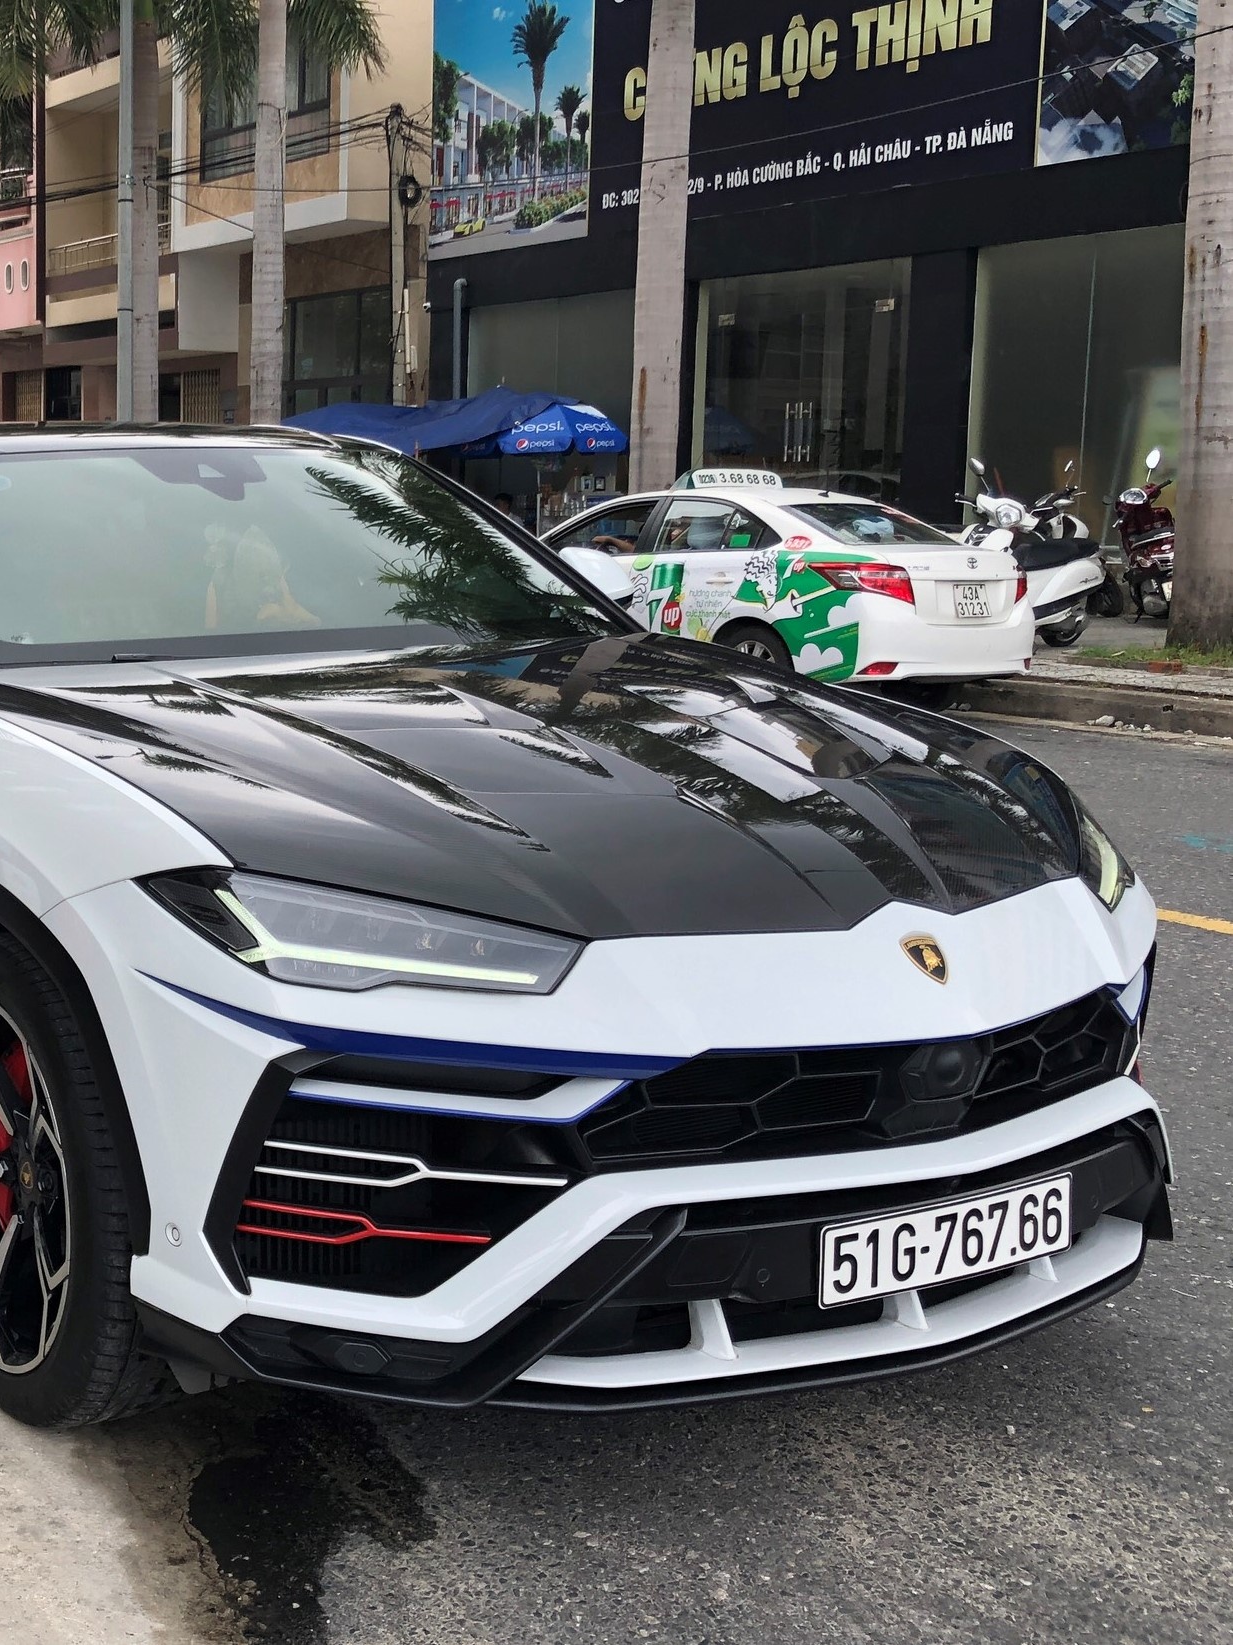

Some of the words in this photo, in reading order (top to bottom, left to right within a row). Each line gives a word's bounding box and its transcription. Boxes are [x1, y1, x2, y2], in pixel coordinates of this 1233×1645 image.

[624, 42, 748, 121] CNG
[760, 14, 838, 98] LỘC
[852, 0, 993, 73] THỊNH
[687, 178, 704, 196] 2/9
[714, 174, 724, 191] P.
[726, 166, 749, 189] HÒA
[752, 161, 793, 184] CƯỜNG
[795, 151, 821, 177] BẮC
[832, 152, 846, 172] Q.
[849, 142, 871, 168] HẢI
[874, 138, 912, 164] CHÂU
[924, 133, 943, 154] TP.
[947, 127, 967, 151] ĐÀ
[971, 119, 1014, 147] NẴNG
[602, 193, 619, 209] ĐC:
[621, 189, 639, 205] 302
[575, 421, 611, 434] pepsi
[529, 439, 555, 449] pepsi
[596, 439, 615, 448] pepsi
[719, 473, 744, 484] 3.68
[746, 474, 760, 485] 68
[762, 474, 776, 486] 68
[962, 586, 980, 601] 43A
[832, 1187, 1063, 1294] 51G-767.66
